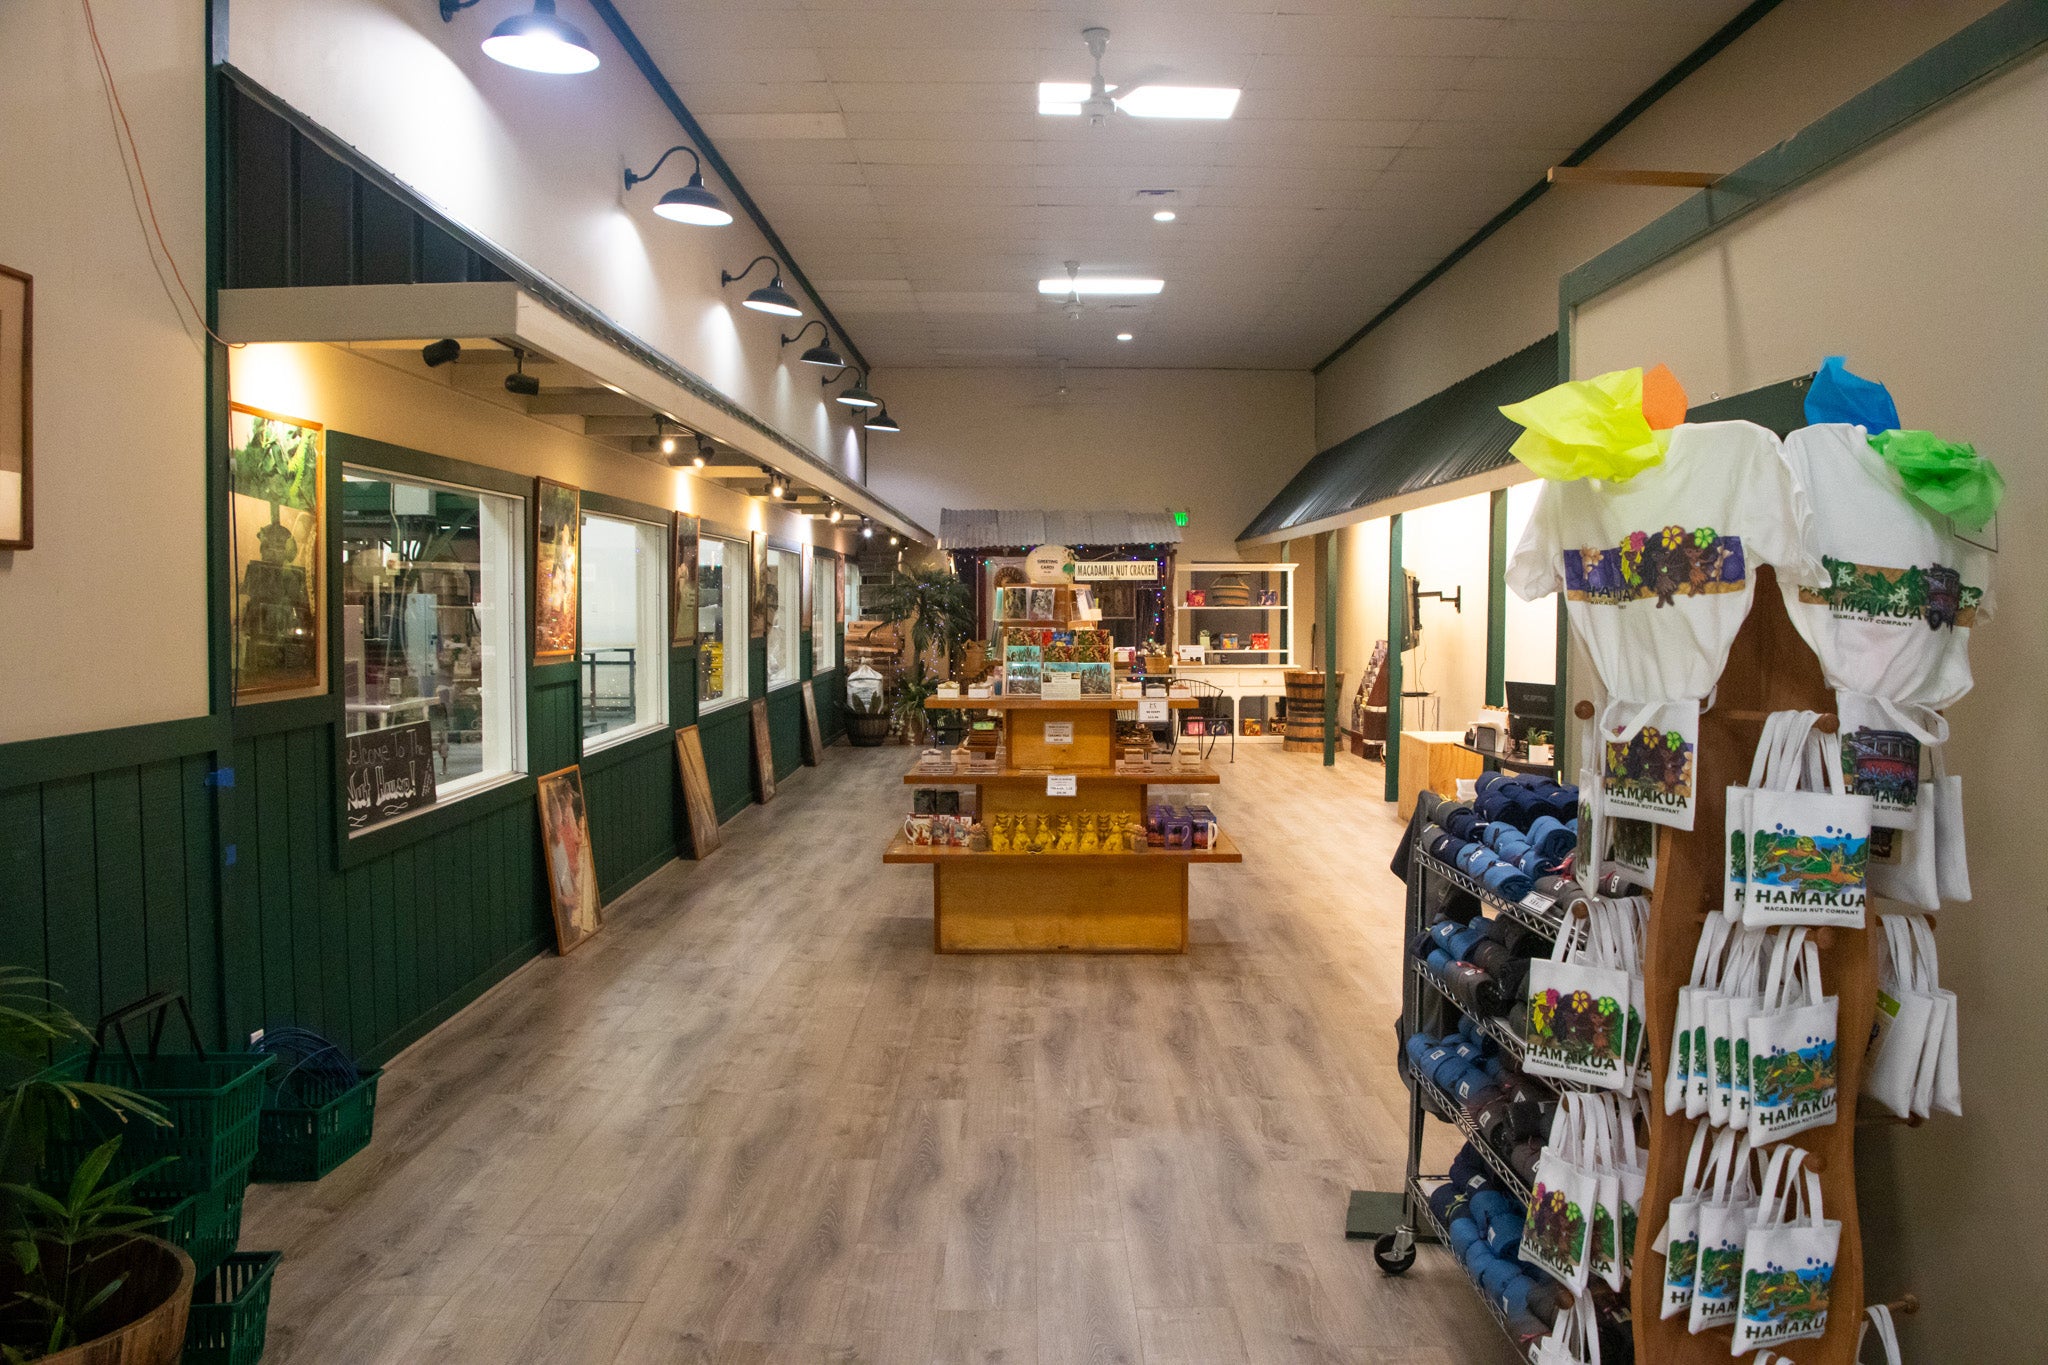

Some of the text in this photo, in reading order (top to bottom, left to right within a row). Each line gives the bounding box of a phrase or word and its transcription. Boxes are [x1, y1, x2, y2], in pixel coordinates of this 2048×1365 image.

[1077, 564, 1156, 576] MACADAMIA NUT CRACKER
[1876, 619, 1912, 627] COMPANY
[390, 730, 406, 758] To
[406, 729, 426, 757] The
[347, 768, 371, 811] Nut
[375, 760, 416, 806] House!
[1605, 783, 1687, 808] HAMAKUA
[1610, 798, 1640, 808] MACADAMIA
[1653, 806, 1680, 814] COMPANY
[1755, 889, 1866, 907] HAMAKUA
[1526, 1043, 1617, 1071] HAMAKUA
[1531, 1057, 1565, 1069] MACADAMIA
[1579, 1067, 1609, 1077] COMPANY
[1745, 1317, 1825, 1340] HAMAKU
